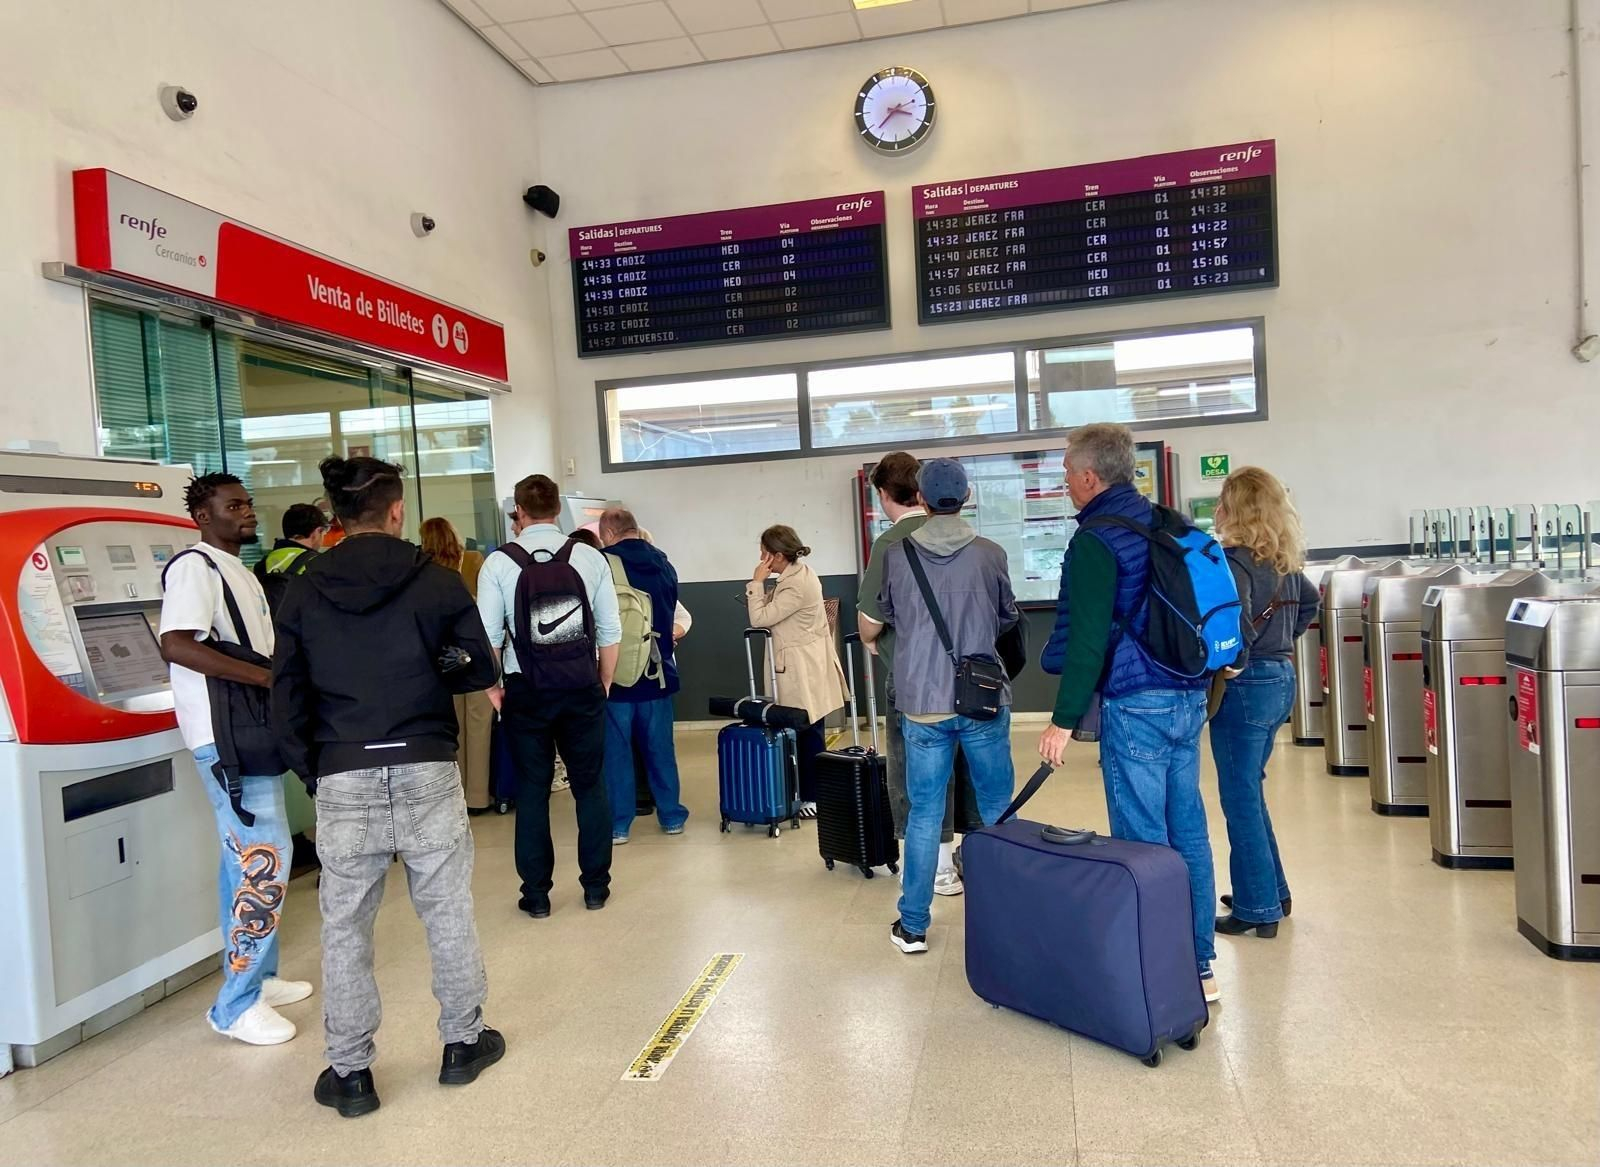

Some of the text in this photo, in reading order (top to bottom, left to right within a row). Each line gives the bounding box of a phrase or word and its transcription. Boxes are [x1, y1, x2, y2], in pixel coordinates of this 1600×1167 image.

[1220, 146, 1262, 163] renfe
[924, 181, 1019, 199] Salidas DEPARTURES
[964, 198, 984, 206] Destino
[1190, 167, 1238, 178] Observaciones
[811, 215, 852, 225] Observaciones
[836, 197, 872, 212] renfe
[927, 218, 958, 231] 14:32
[965, 214, 997, 226] JEREZ
[1004, 210, 1024, 222] FRA
[1086, 200, 1106, 212] CER
[1191, 185, 1226, 199] 14:32
[120, 214, 167, 240] renfe
[579, 225, 662, 240] Salidas DEPARTURES
[928, 202, 1227, 248] 14:32 JEREZ FRA CER 01 14:32
[582, 259, 611, 270] 14:33
[617, 255, 646, 267] CADIZ
[782, 238, 794, 249] 04
[928, 220, 1228, 264] 14:40 JEREZ FRA CER 01 14:22
[584, 254, 795, 286] 14:36 CADIZ CER 02
[929, 238, 1228, 280] 14:57 JEREZ FRA CER 01 14:57
[584, 290, 613, 301] 14:39
[619, 287, 648, 298] CADIZ
[784, 270, 796, 280] 04
[929, 284, 961, 297] 15:06
[968, 279, 1014, 293] SEVILLA
[1157, 262, 1171, 273] 01
[1193, 255, 1228, 269] 15:06
[308, 274, 425, 335] Venta de Billetes
[586, 287, 797, 317] 14:50 CADIZ CER 02
[930, 272, 1229, 314] 15:23 JEREZ FRA CER 01 15:23
[588, 303, 798, 333] 15:22 CADIZ CER 02
[727, 325, 744, 335] CER
[787, 319, 799, 328] 02
